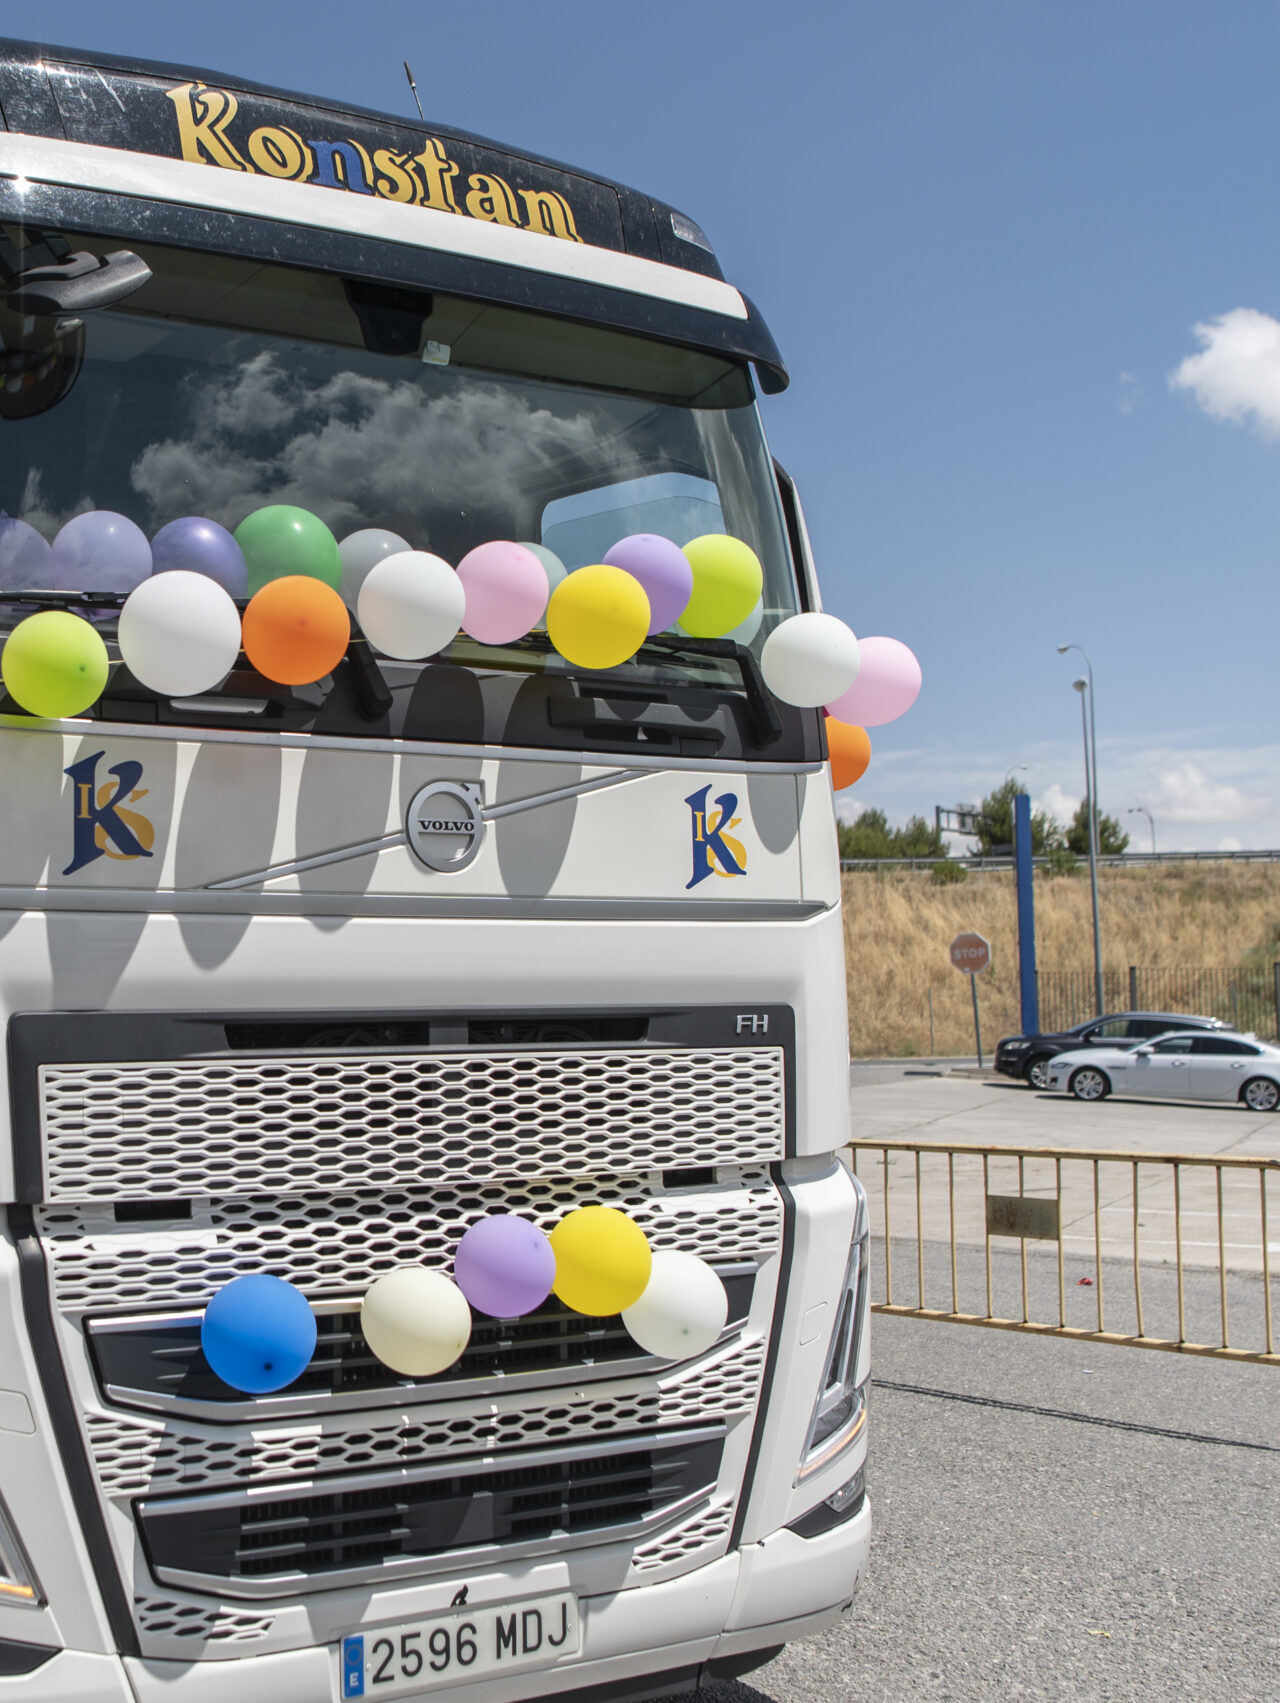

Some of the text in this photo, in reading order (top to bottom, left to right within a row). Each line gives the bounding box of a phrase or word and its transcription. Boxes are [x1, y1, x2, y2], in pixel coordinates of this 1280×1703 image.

[166, 81, 584, 243] Konstan
[418, 820, 475, 832] VOLVO
[953, 947, 985, 960] STOP
[736, 1014, 768, 1034] FH
[350, 1602, 567, 1686] E 2596 MDJ
